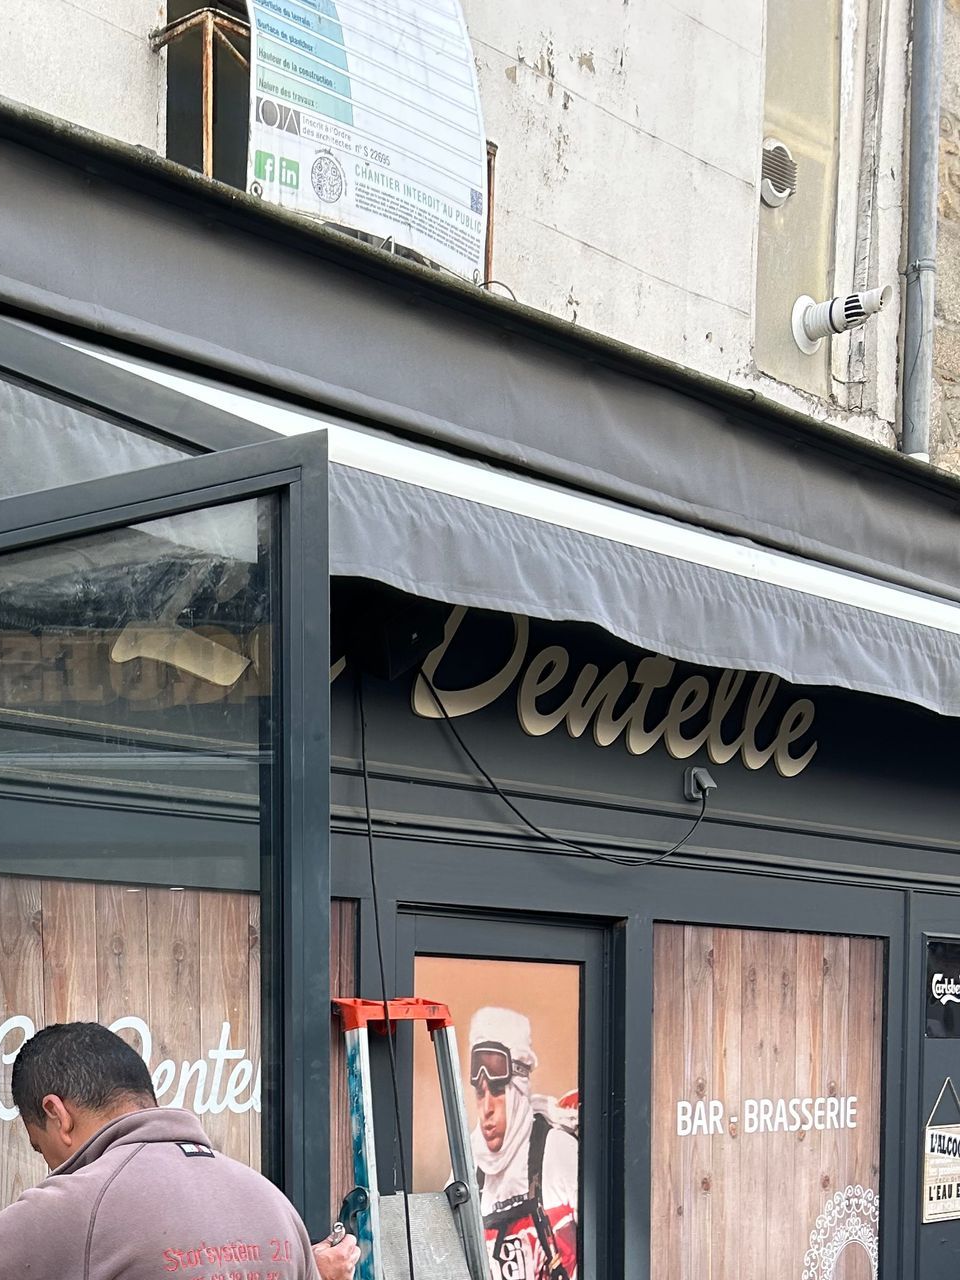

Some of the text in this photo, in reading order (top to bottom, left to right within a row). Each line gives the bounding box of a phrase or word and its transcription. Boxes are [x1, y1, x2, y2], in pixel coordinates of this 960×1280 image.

[258, 47, 282, 65] Hauteur
[292, 61, 297, 72] la
[299, 66, 333, 88] construction
[258, 77, 279, 94] Nature
[280, 86, 291, 99] des
[292, 91, 315, 107] travaux
[302, 115, 325, 131] Inscrit
[302, 126, 315, 137] des
[316, 131, 352, 151] architectes
[355, 163, 400, 191] CHANTIER
[403, 184, 440, 211] INTERDIT
[443, 203, 453, 219] AU
[455, 209, 481, 235] PUBLIC
[411, 604, 817, 778] Dentelle
[676, 1099, 724, 1136] BAR
[743, 1096, 858, 1134] BRASSERIE
[929, 1184, 953, 1201] L'EAU
